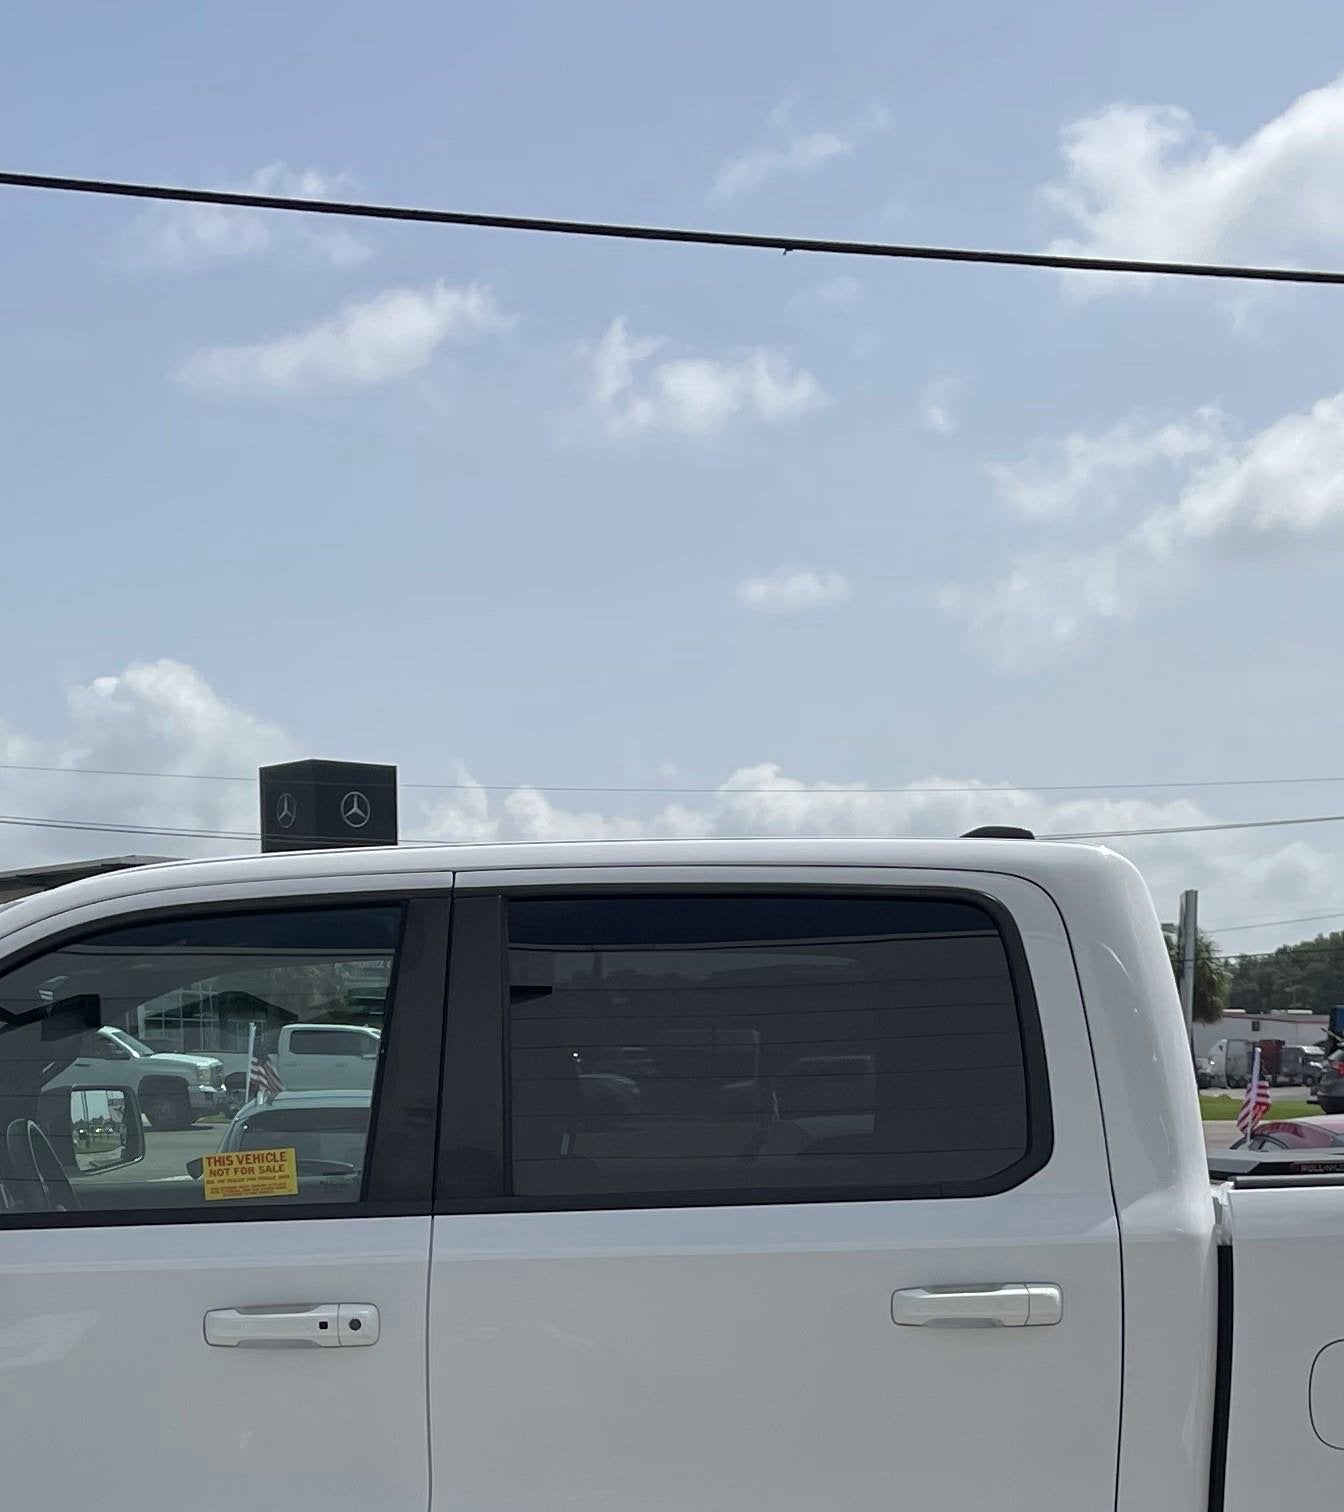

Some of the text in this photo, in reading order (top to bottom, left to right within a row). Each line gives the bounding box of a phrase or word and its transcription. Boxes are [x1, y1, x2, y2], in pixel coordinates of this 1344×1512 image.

[206, 1151, 287, 1167] THIS VEHICLE
[209, 1164, 285, 1177] NOT FOR SALE
